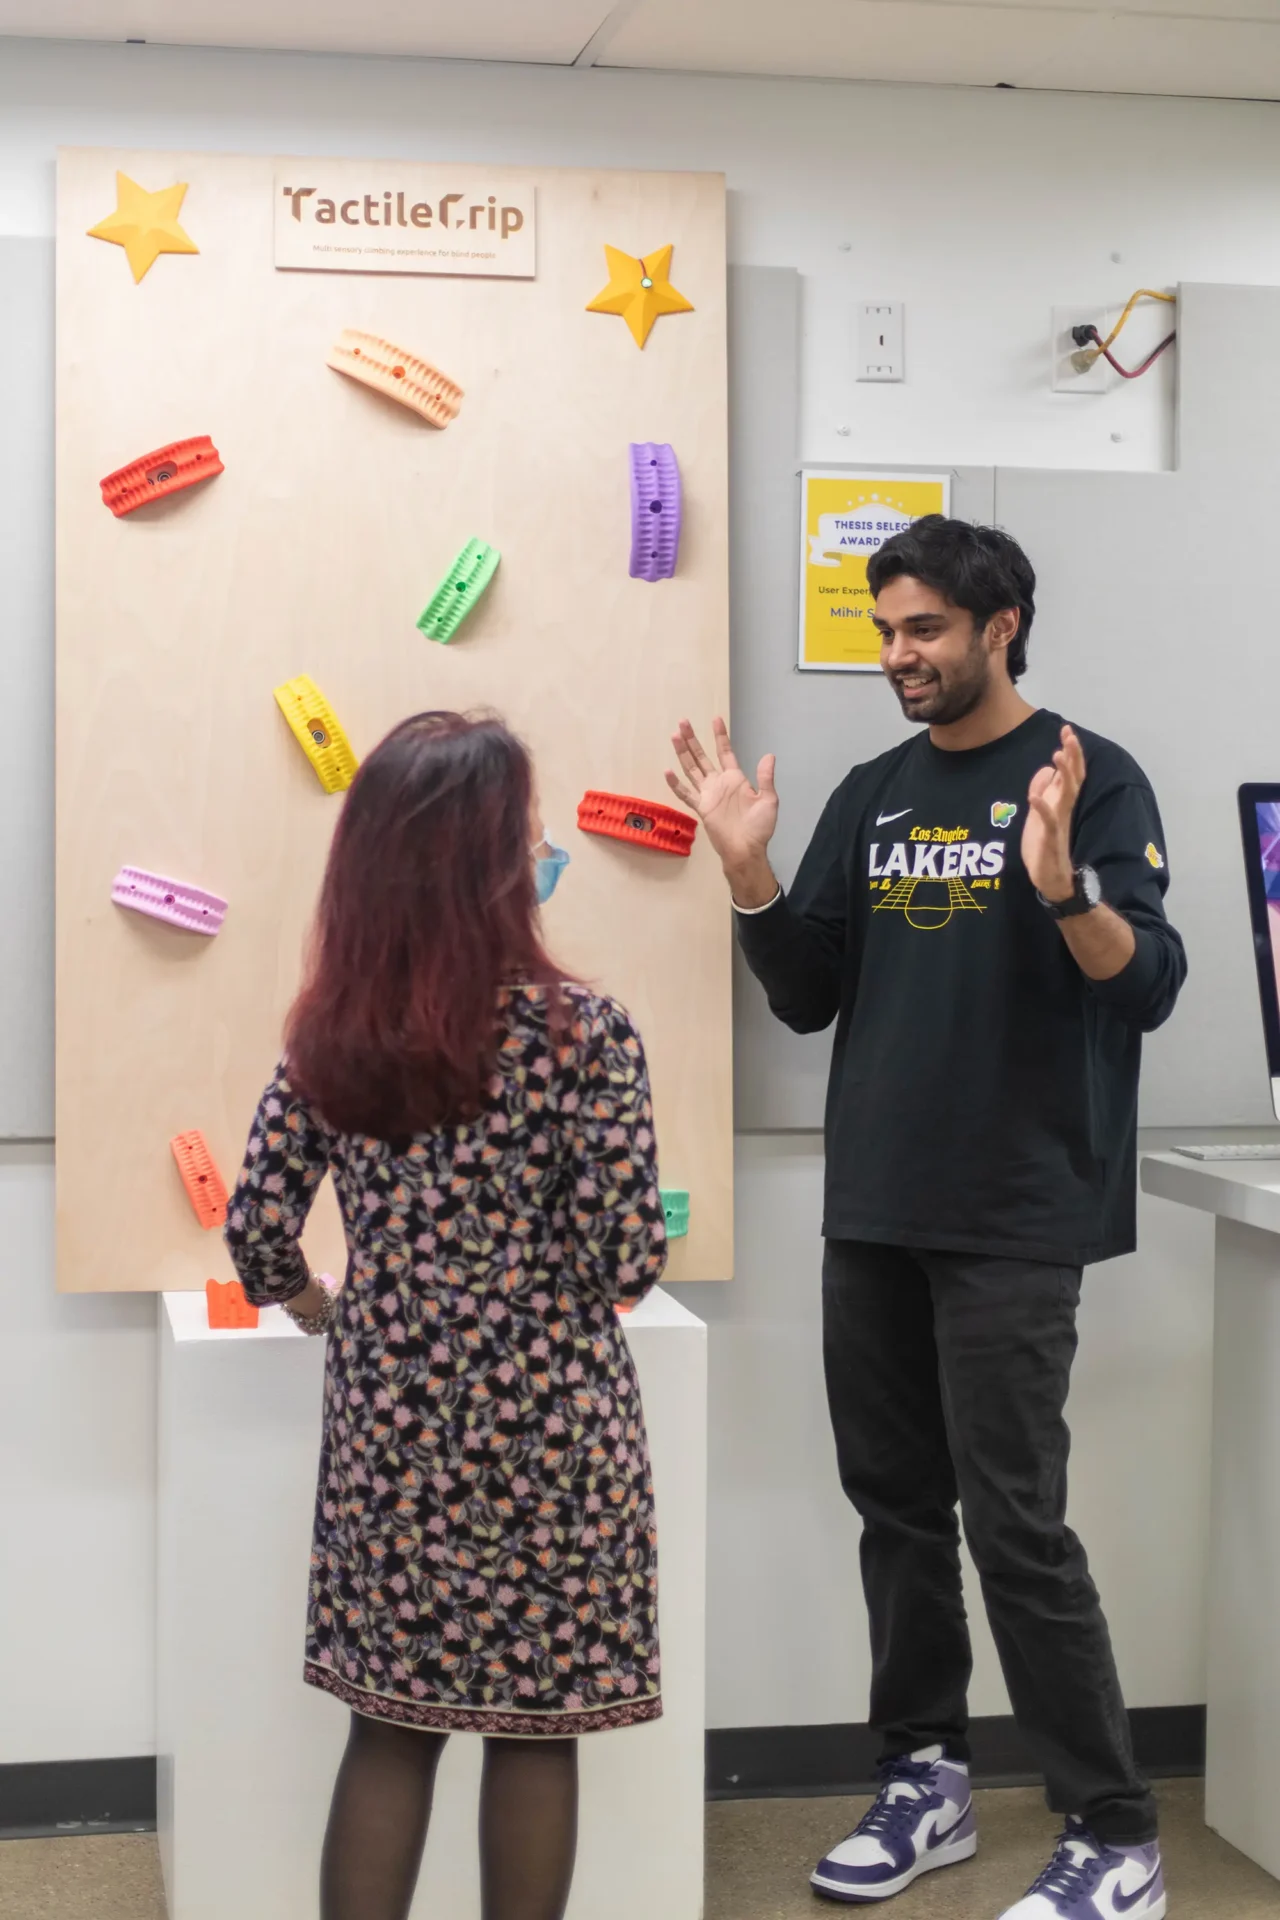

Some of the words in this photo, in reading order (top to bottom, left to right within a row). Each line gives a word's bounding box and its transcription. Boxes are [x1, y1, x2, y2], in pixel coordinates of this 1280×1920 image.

[312, 244, 333, 252] Multi
[334, 246, 362, 254] sensory
[364, 247, 395, 256] climbing
[397, 248, 437, 257] experience
[452, 250, 470, 258] blind
[471, 251, 497, 260] people
[835, 520, 873, 530] THESIS
[839, 536, 881, 546] AWARD
[818, 586, 839, 594] User
[830, 606, 863, 618] Mihir
[909, 826, 930, 841] Los
[930, 826, 969, 845] Angeles
[868, 842, 1005, 878] LAKERS
